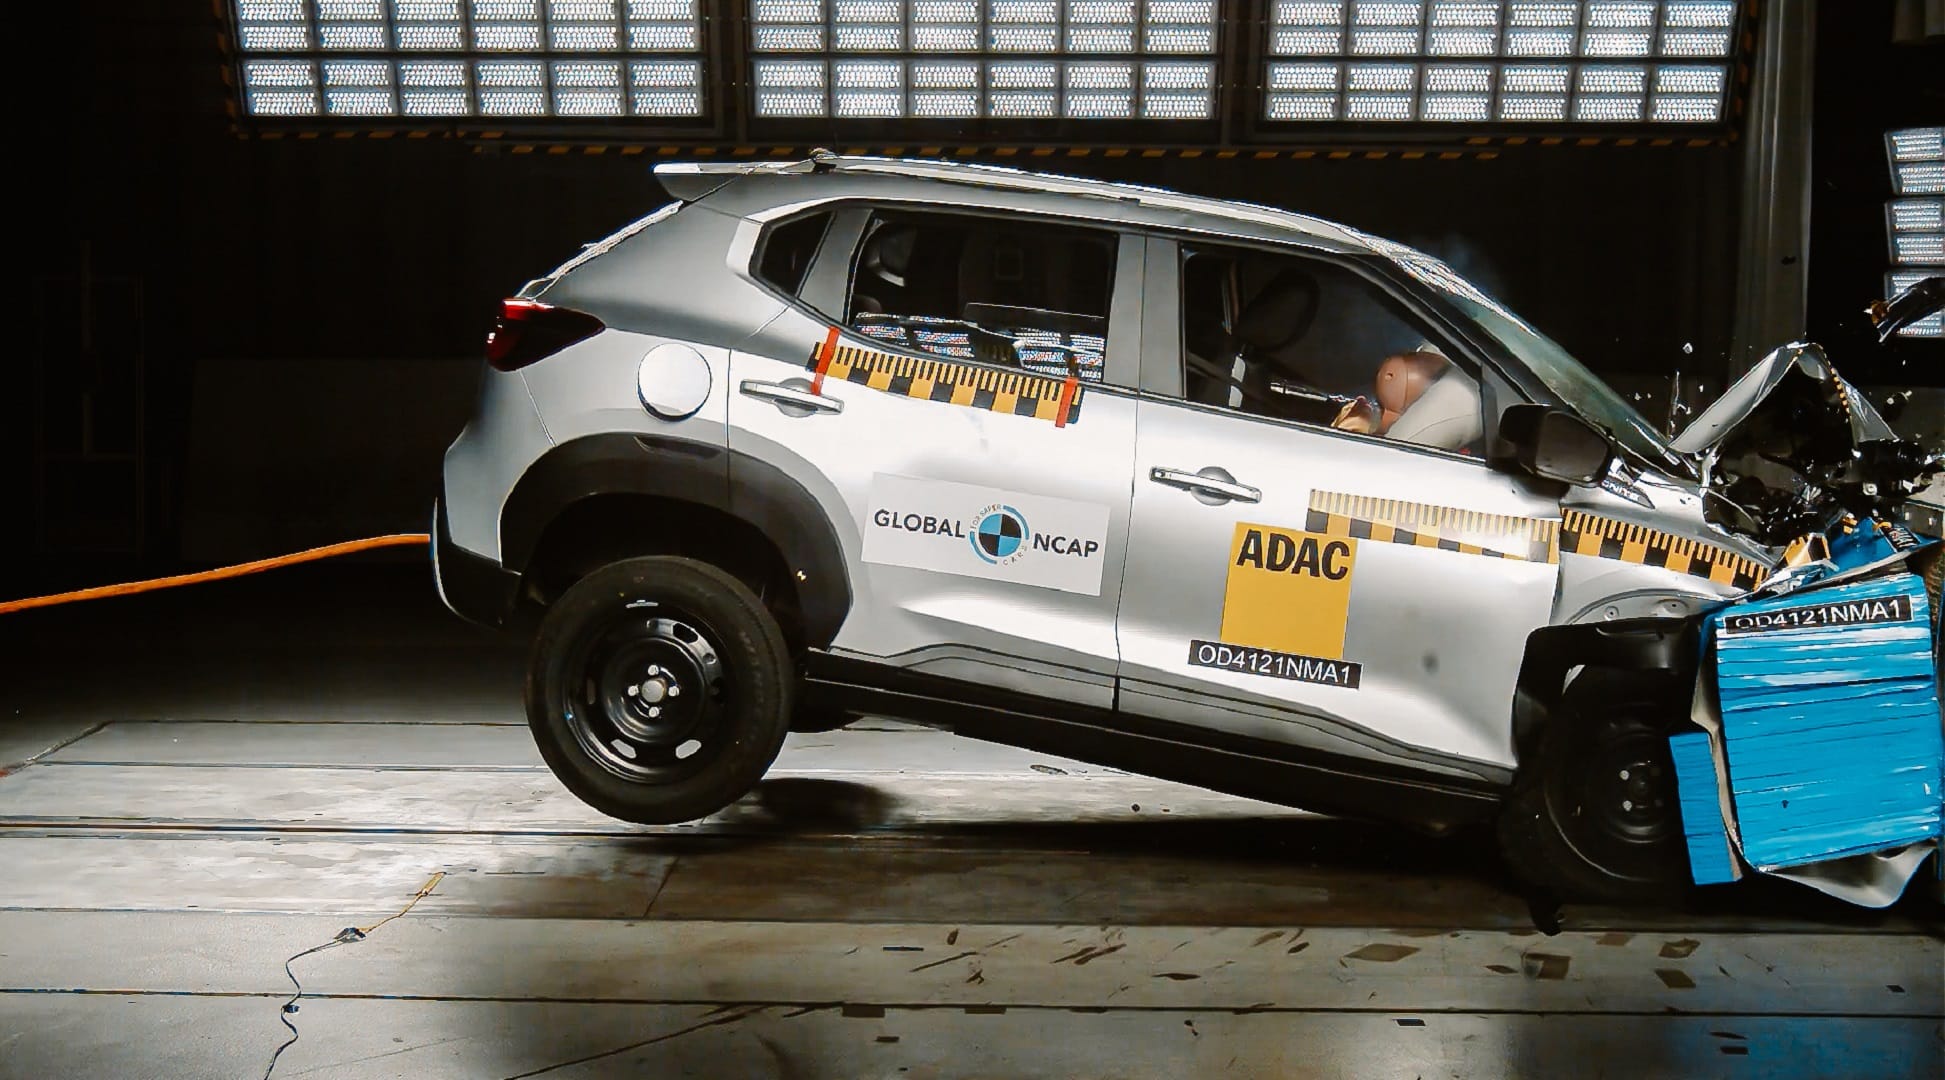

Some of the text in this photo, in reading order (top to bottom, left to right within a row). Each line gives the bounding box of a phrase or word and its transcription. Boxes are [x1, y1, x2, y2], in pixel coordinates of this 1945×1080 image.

[874, 508, 1099, 558] GLOBAL NCAP
[1236, 529, 1350, 581] ADAC
[1735, 599, 1900, 630] OD4121NMA1
[1198, 644, 1350, 684] OD4121NMA1
